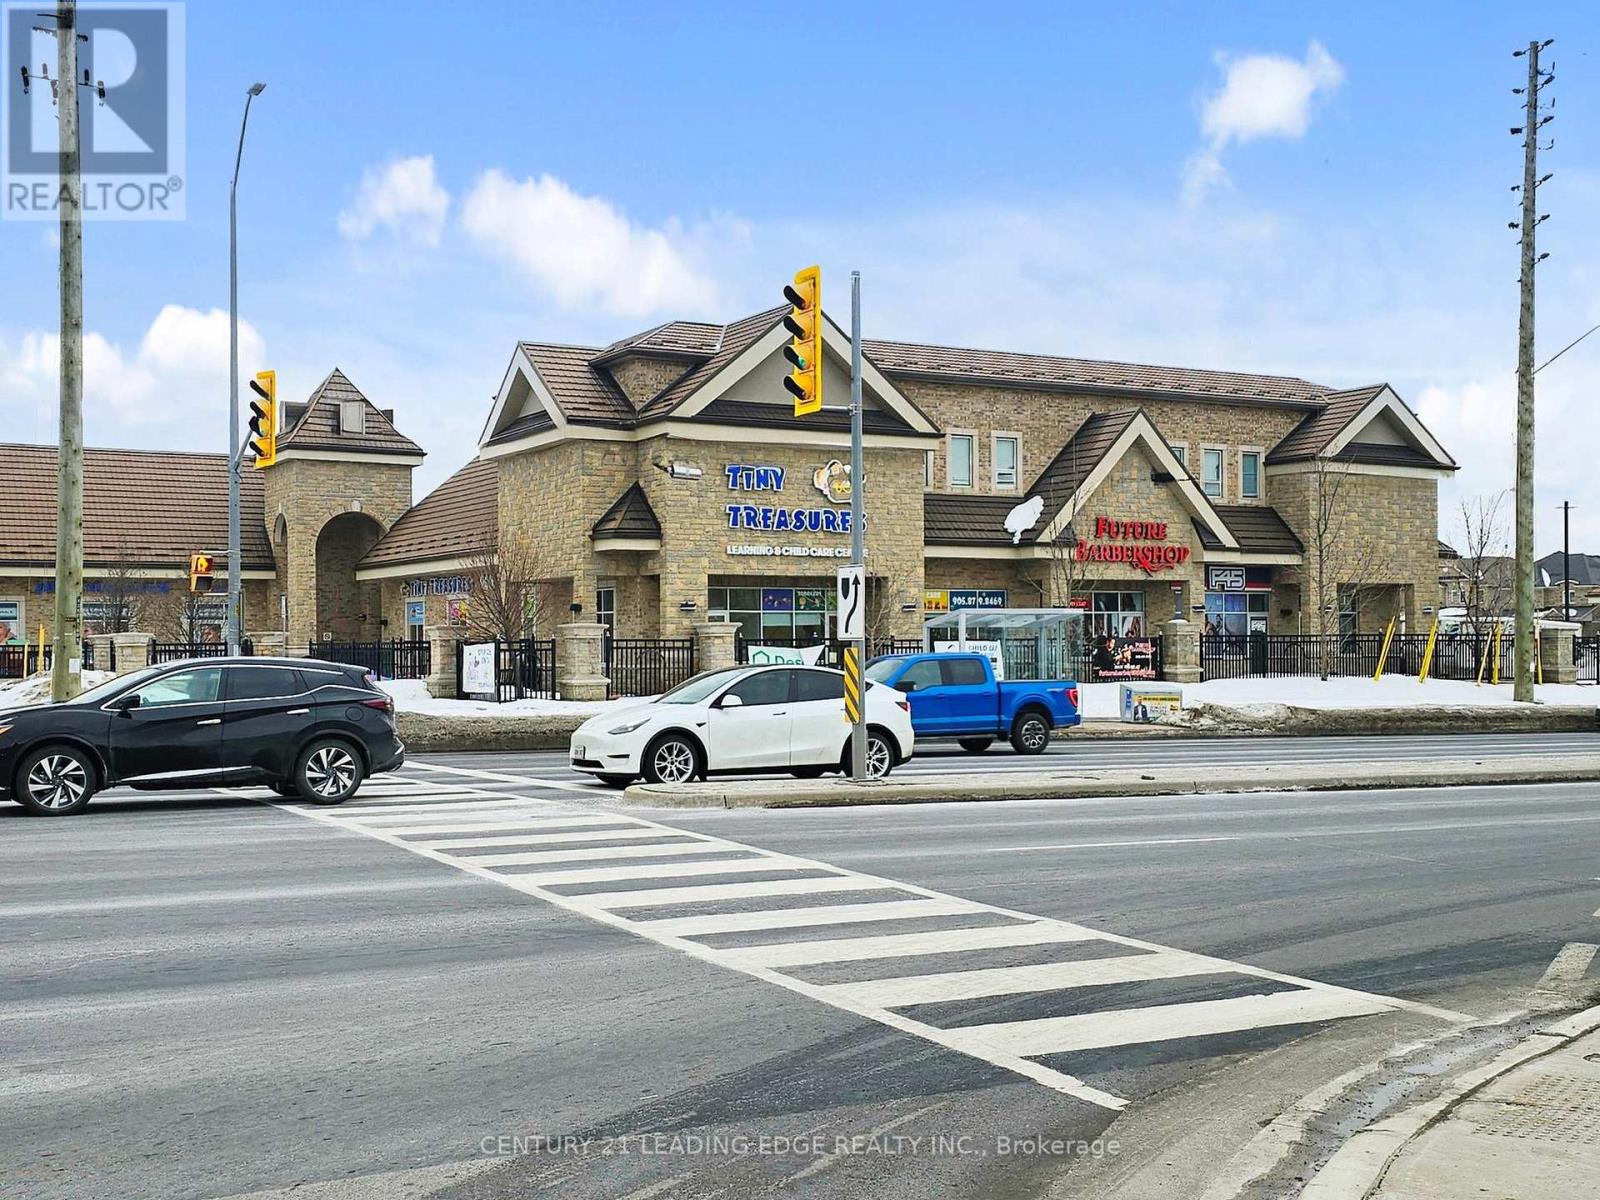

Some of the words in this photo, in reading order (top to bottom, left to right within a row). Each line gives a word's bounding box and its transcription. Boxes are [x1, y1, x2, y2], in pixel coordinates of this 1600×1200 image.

[1094, 517, 1168, 540] FUTURE
[726, 545, 774, 556] LEARNING
[782, 546, 810, 557] CHILD
[810, 547, 834, 557] CARE
[1075, 539, 1191, 563] BARBERSHOP
[1210, 567, 1244, 589] F45
